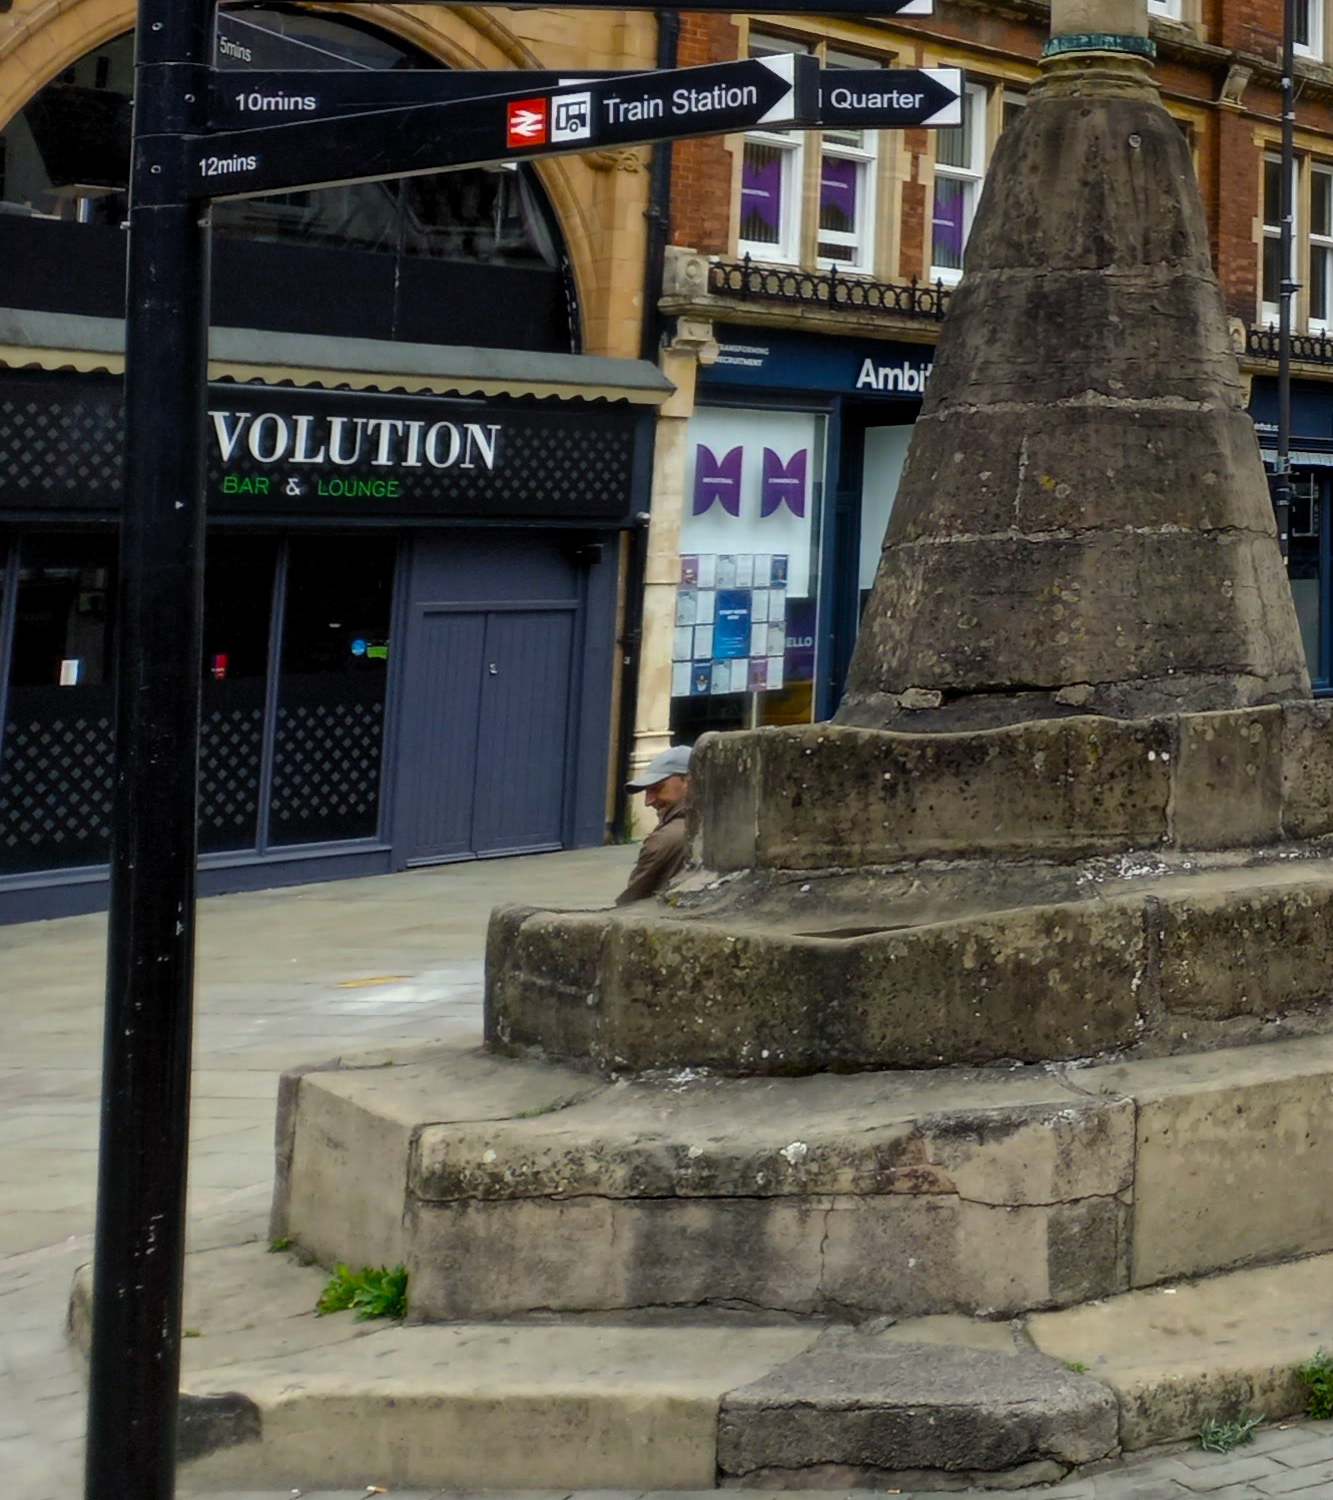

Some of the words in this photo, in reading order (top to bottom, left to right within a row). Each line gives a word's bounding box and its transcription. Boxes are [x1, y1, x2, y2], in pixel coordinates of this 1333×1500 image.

[218, 35, 252, 62] 5mins
[235, 90, 317, 111] 10mins
[602, 95, 664, 124] Train
[671, 84, 758, 116] Station
[830, 87, 925, 110] Quarter
[198, 154, 257, 177] 12mins
[207, 410, 501, 471] VOLUTION
[223, 475, 270, 495] BAR
[285, 477, 301, 496] &
[317, 478, 401, 498] LOUNGE
